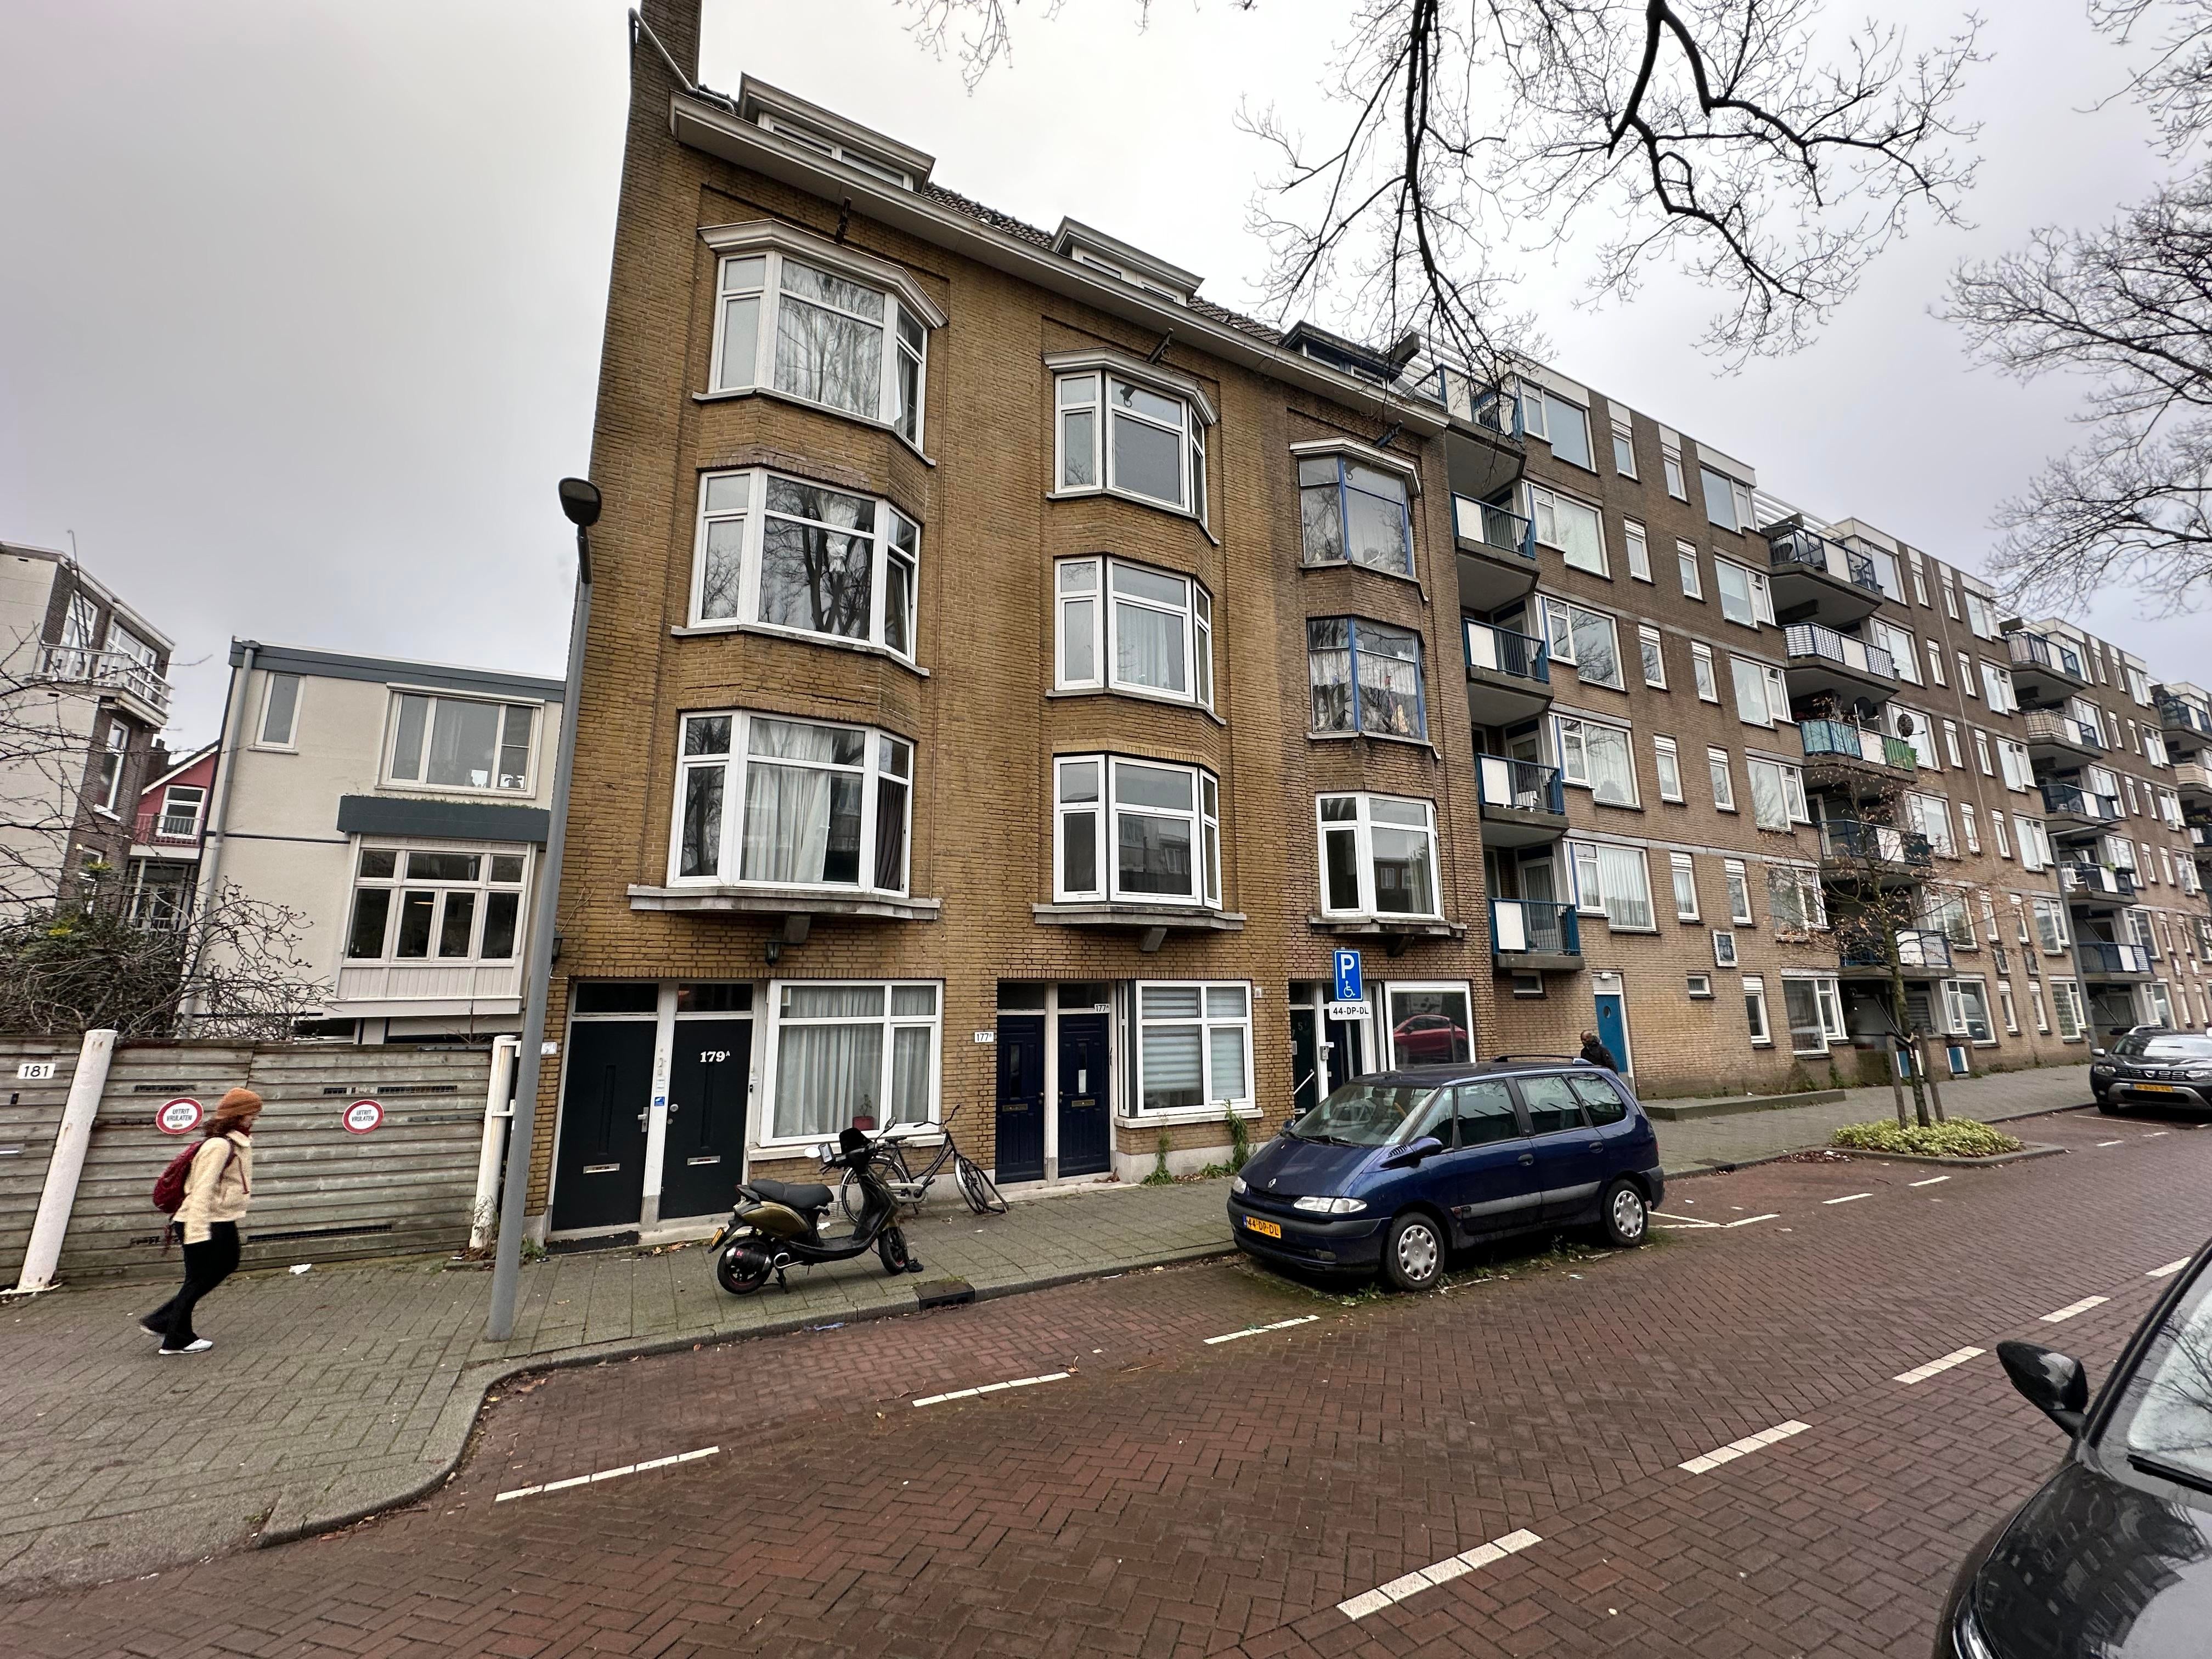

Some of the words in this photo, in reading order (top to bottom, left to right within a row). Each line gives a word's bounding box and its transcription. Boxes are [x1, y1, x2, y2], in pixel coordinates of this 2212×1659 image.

[1340, 953, 1355, 979] P
[1333, 1007, 1369, 1015] 44-DP-DL
[700, 1050, 730, 1063] 179A
[24, 1065, 49, 1077] 181
[1248, 1218, 1279, 1236] 44-DP-DL
